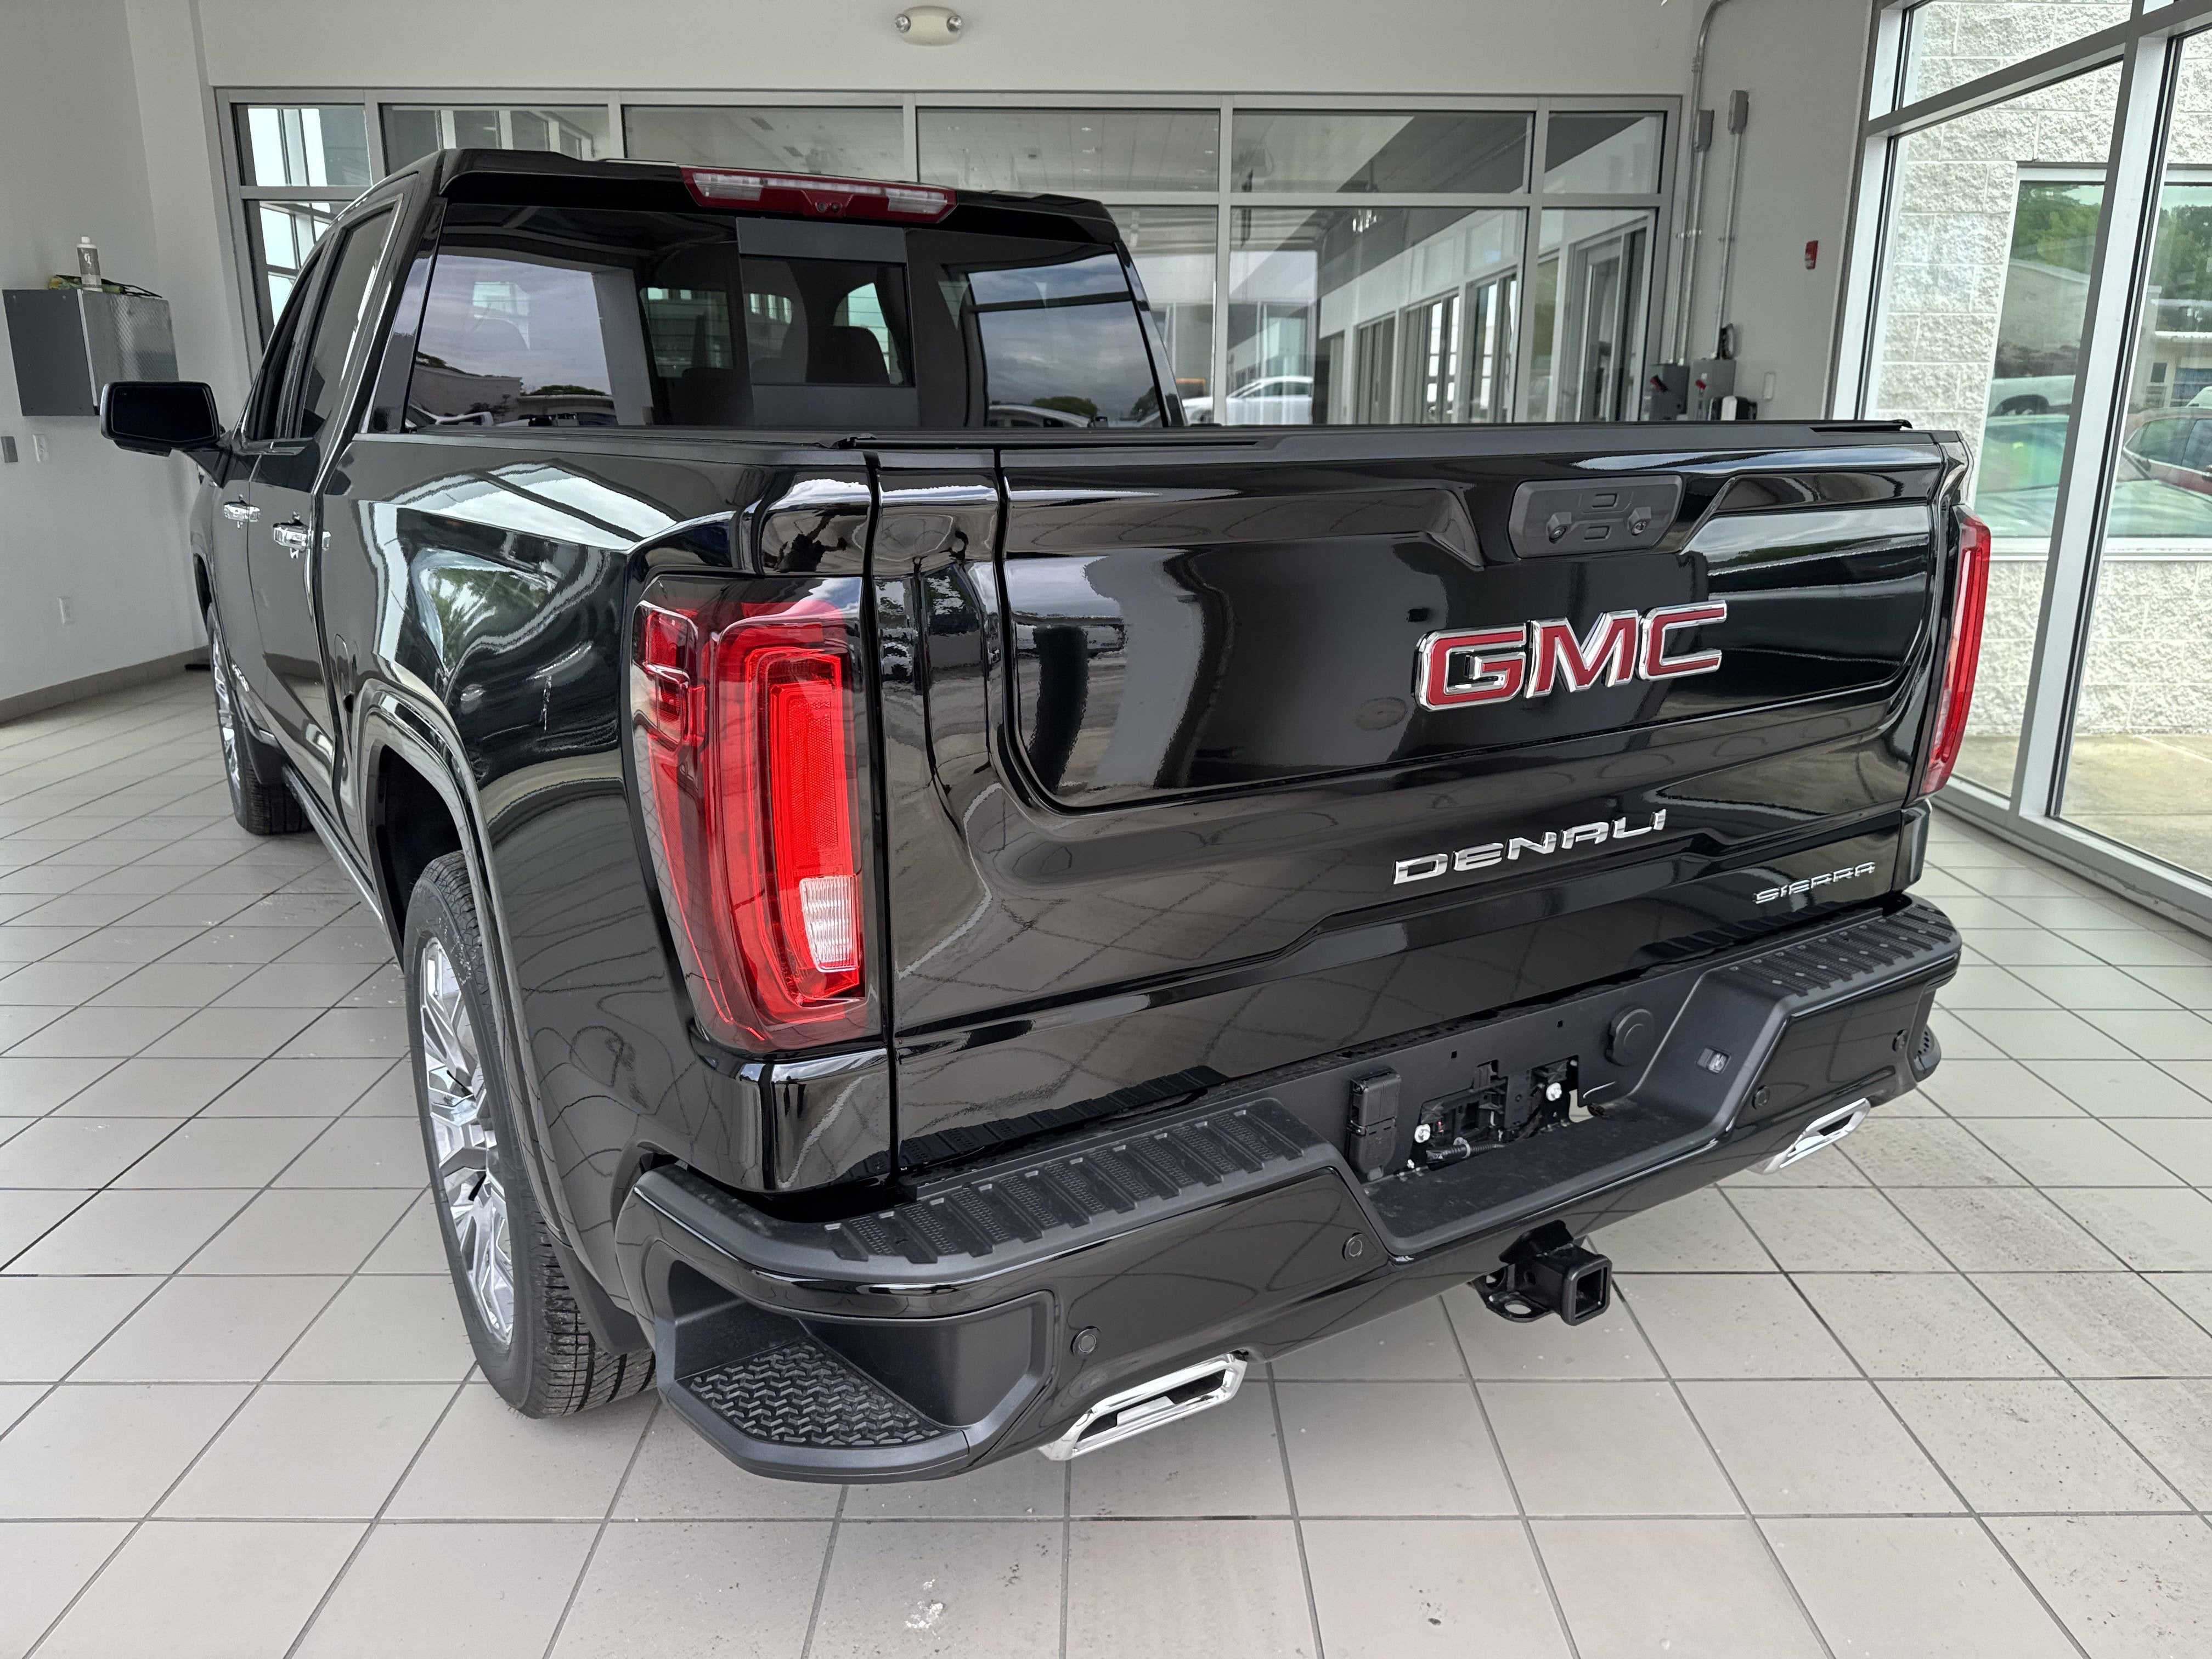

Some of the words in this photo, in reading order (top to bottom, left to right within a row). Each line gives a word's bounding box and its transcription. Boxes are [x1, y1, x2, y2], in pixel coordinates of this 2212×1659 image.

[1414, 600, 1727, 712] GMC
[1393, 809, 1666, 885] DENALI
[1754, 861, 1876, 904] SIERRA
